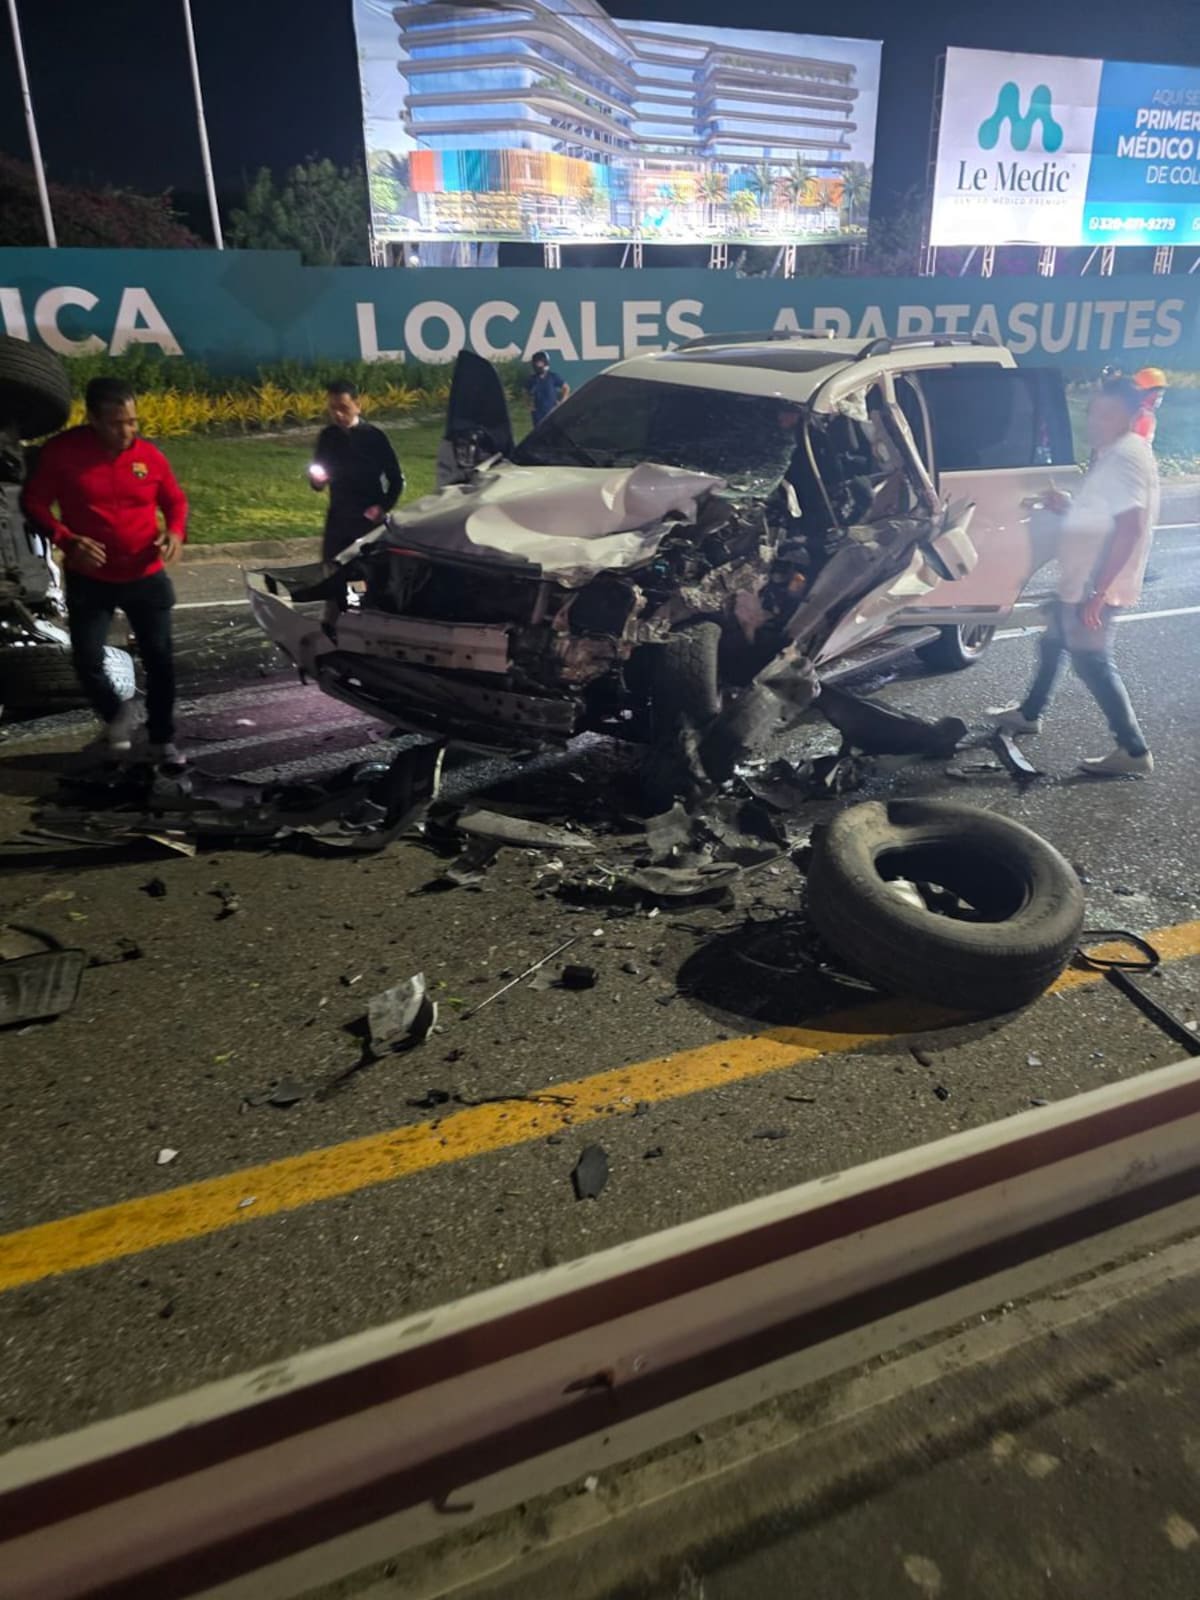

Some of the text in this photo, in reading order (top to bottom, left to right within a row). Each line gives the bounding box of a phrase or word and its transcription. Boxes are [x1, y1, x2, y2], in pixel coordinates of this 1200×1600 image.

[1117, 130, 1194, 160] MÉDICO
[957, 160, 1070, 193] Le Medic
[1145, 165, 1200, 185] DE COL
[0, 285, 184, 358] ICA
[356, 299, 706, 364] LOCALES
[773, 298, 1185, 354] APARTASUITES
